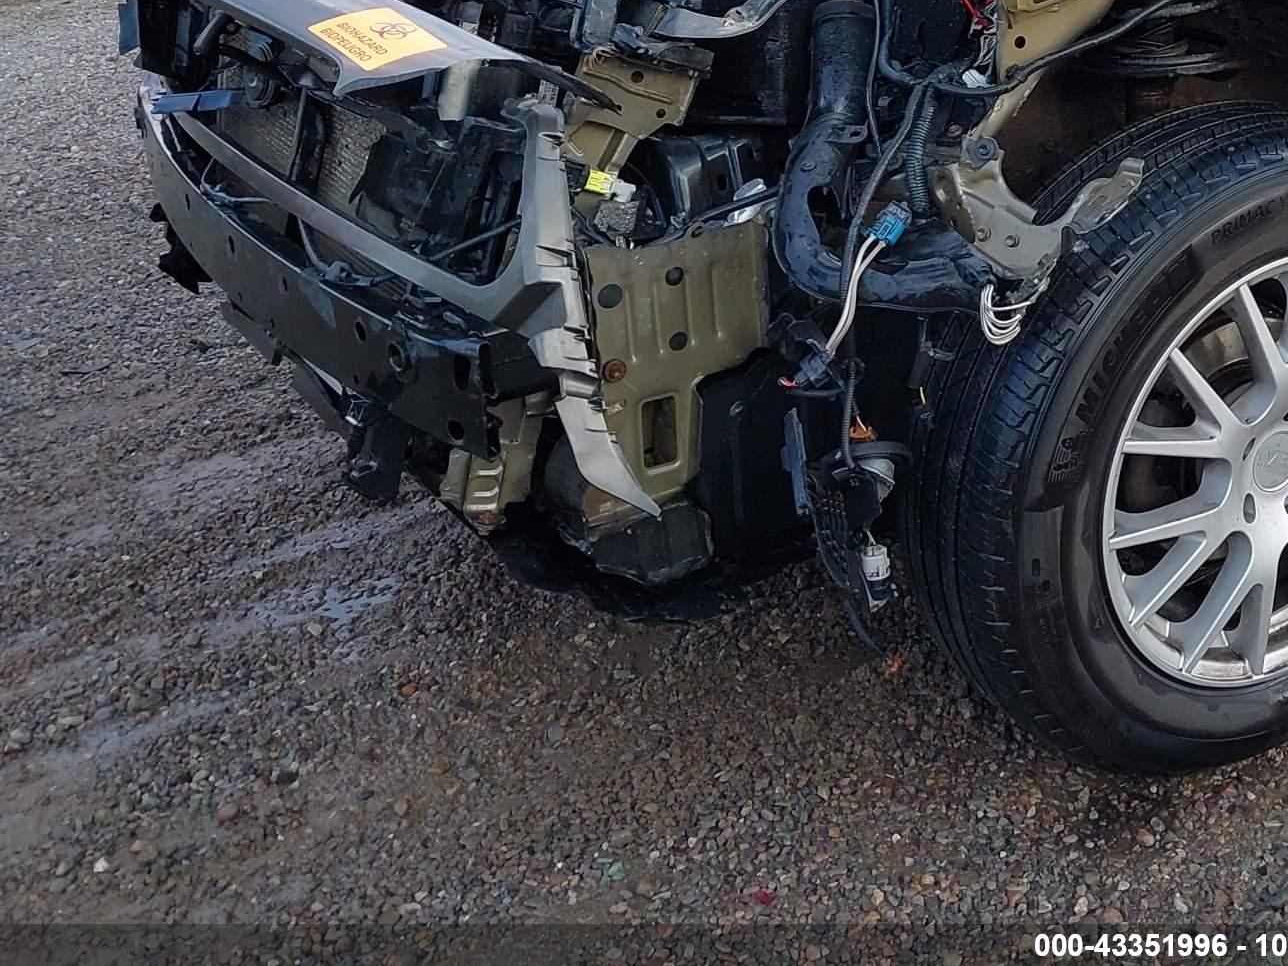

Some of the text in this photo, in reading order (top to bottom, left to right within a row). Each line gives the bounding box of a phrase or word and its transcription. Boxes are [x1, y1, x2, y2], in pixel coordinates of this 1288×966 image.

[319, 27, 372, 62] BIOPELIGRO
[336, 22, 388, 55] BIOHAZARD
[1210, 193, 1288, 246] PRIMACY
